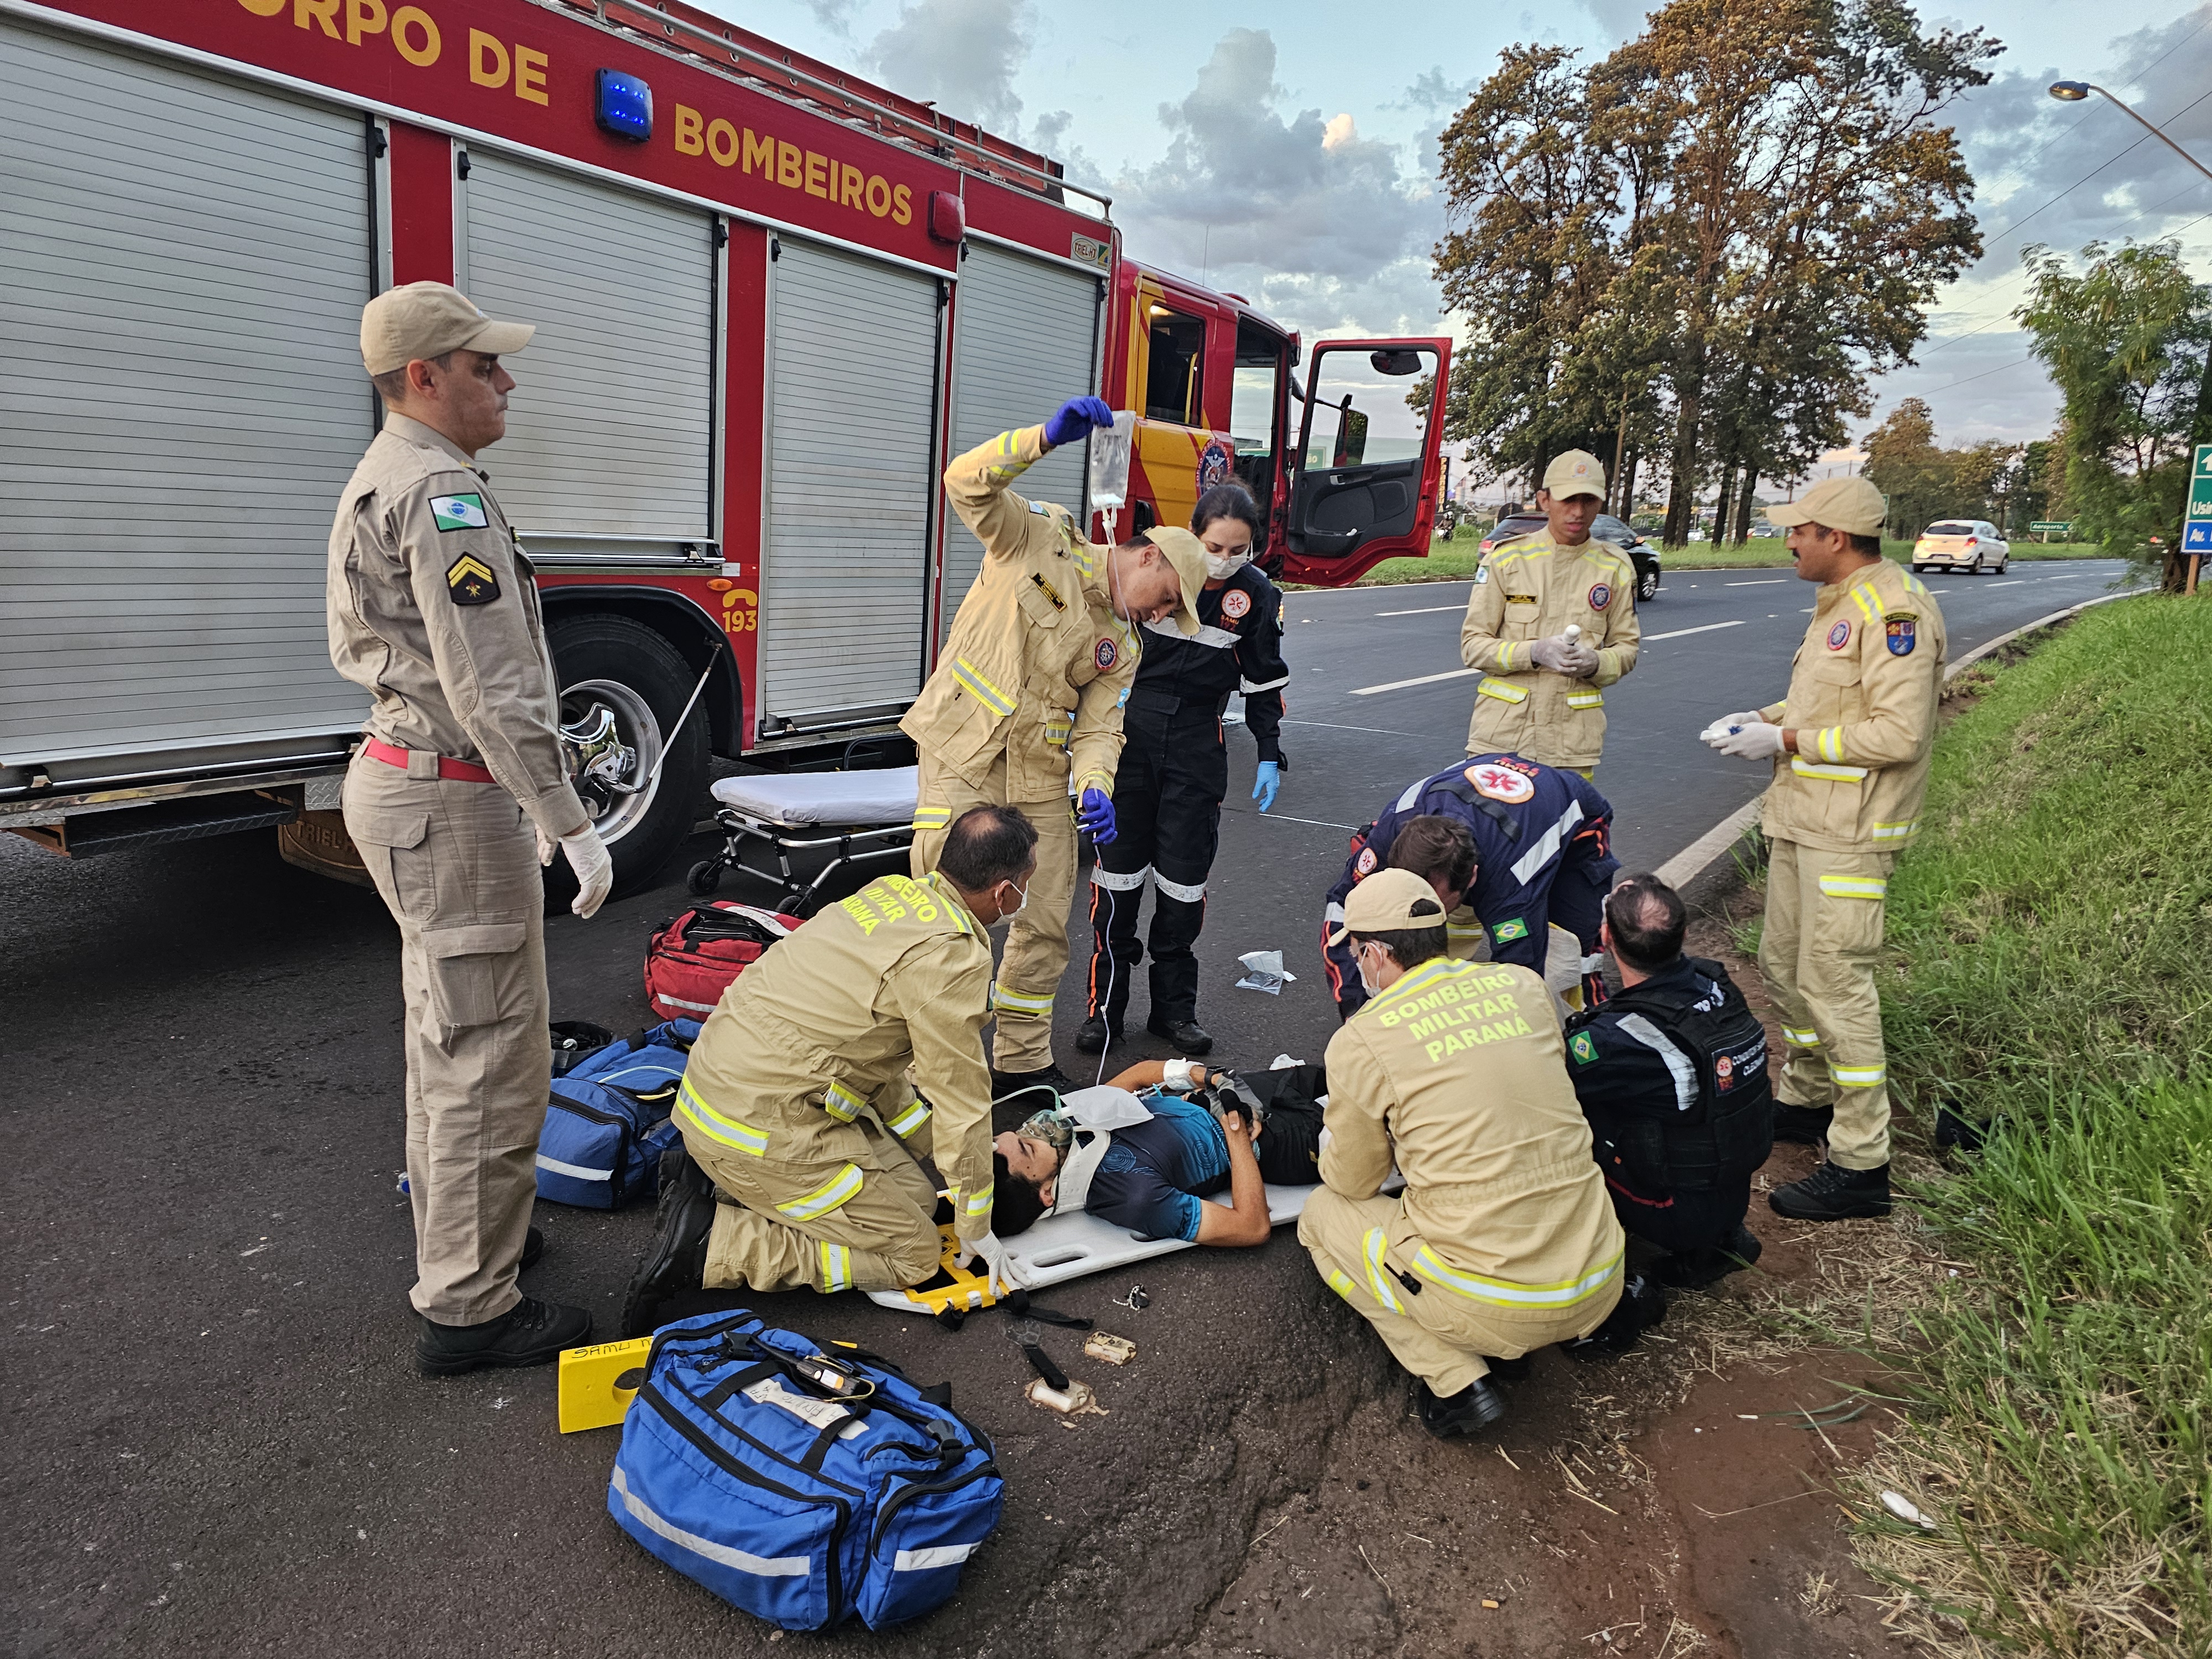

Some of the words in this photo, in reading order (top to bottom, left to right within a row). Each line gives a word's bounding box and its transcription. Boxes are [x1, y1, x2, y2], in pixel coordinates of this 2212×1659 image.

[237, 0, 441, 66] RPO
[469, 27, 549, 107] DE
[675, 103, 912, 226] BOMBEIROS
[2189, 528, 2205, 542] Av.
[722, 610, 757, 632] 193
[296, 820, 357, 854] TRIEL-H
[1379, 973, 1516, 1027] BOMBEIRO
[1408, 993, 1520, 1040] MILITAR
[1425, 1012, 1533, 1063] PARANÁ
[572, 1342, 630, 1359] SAMU
